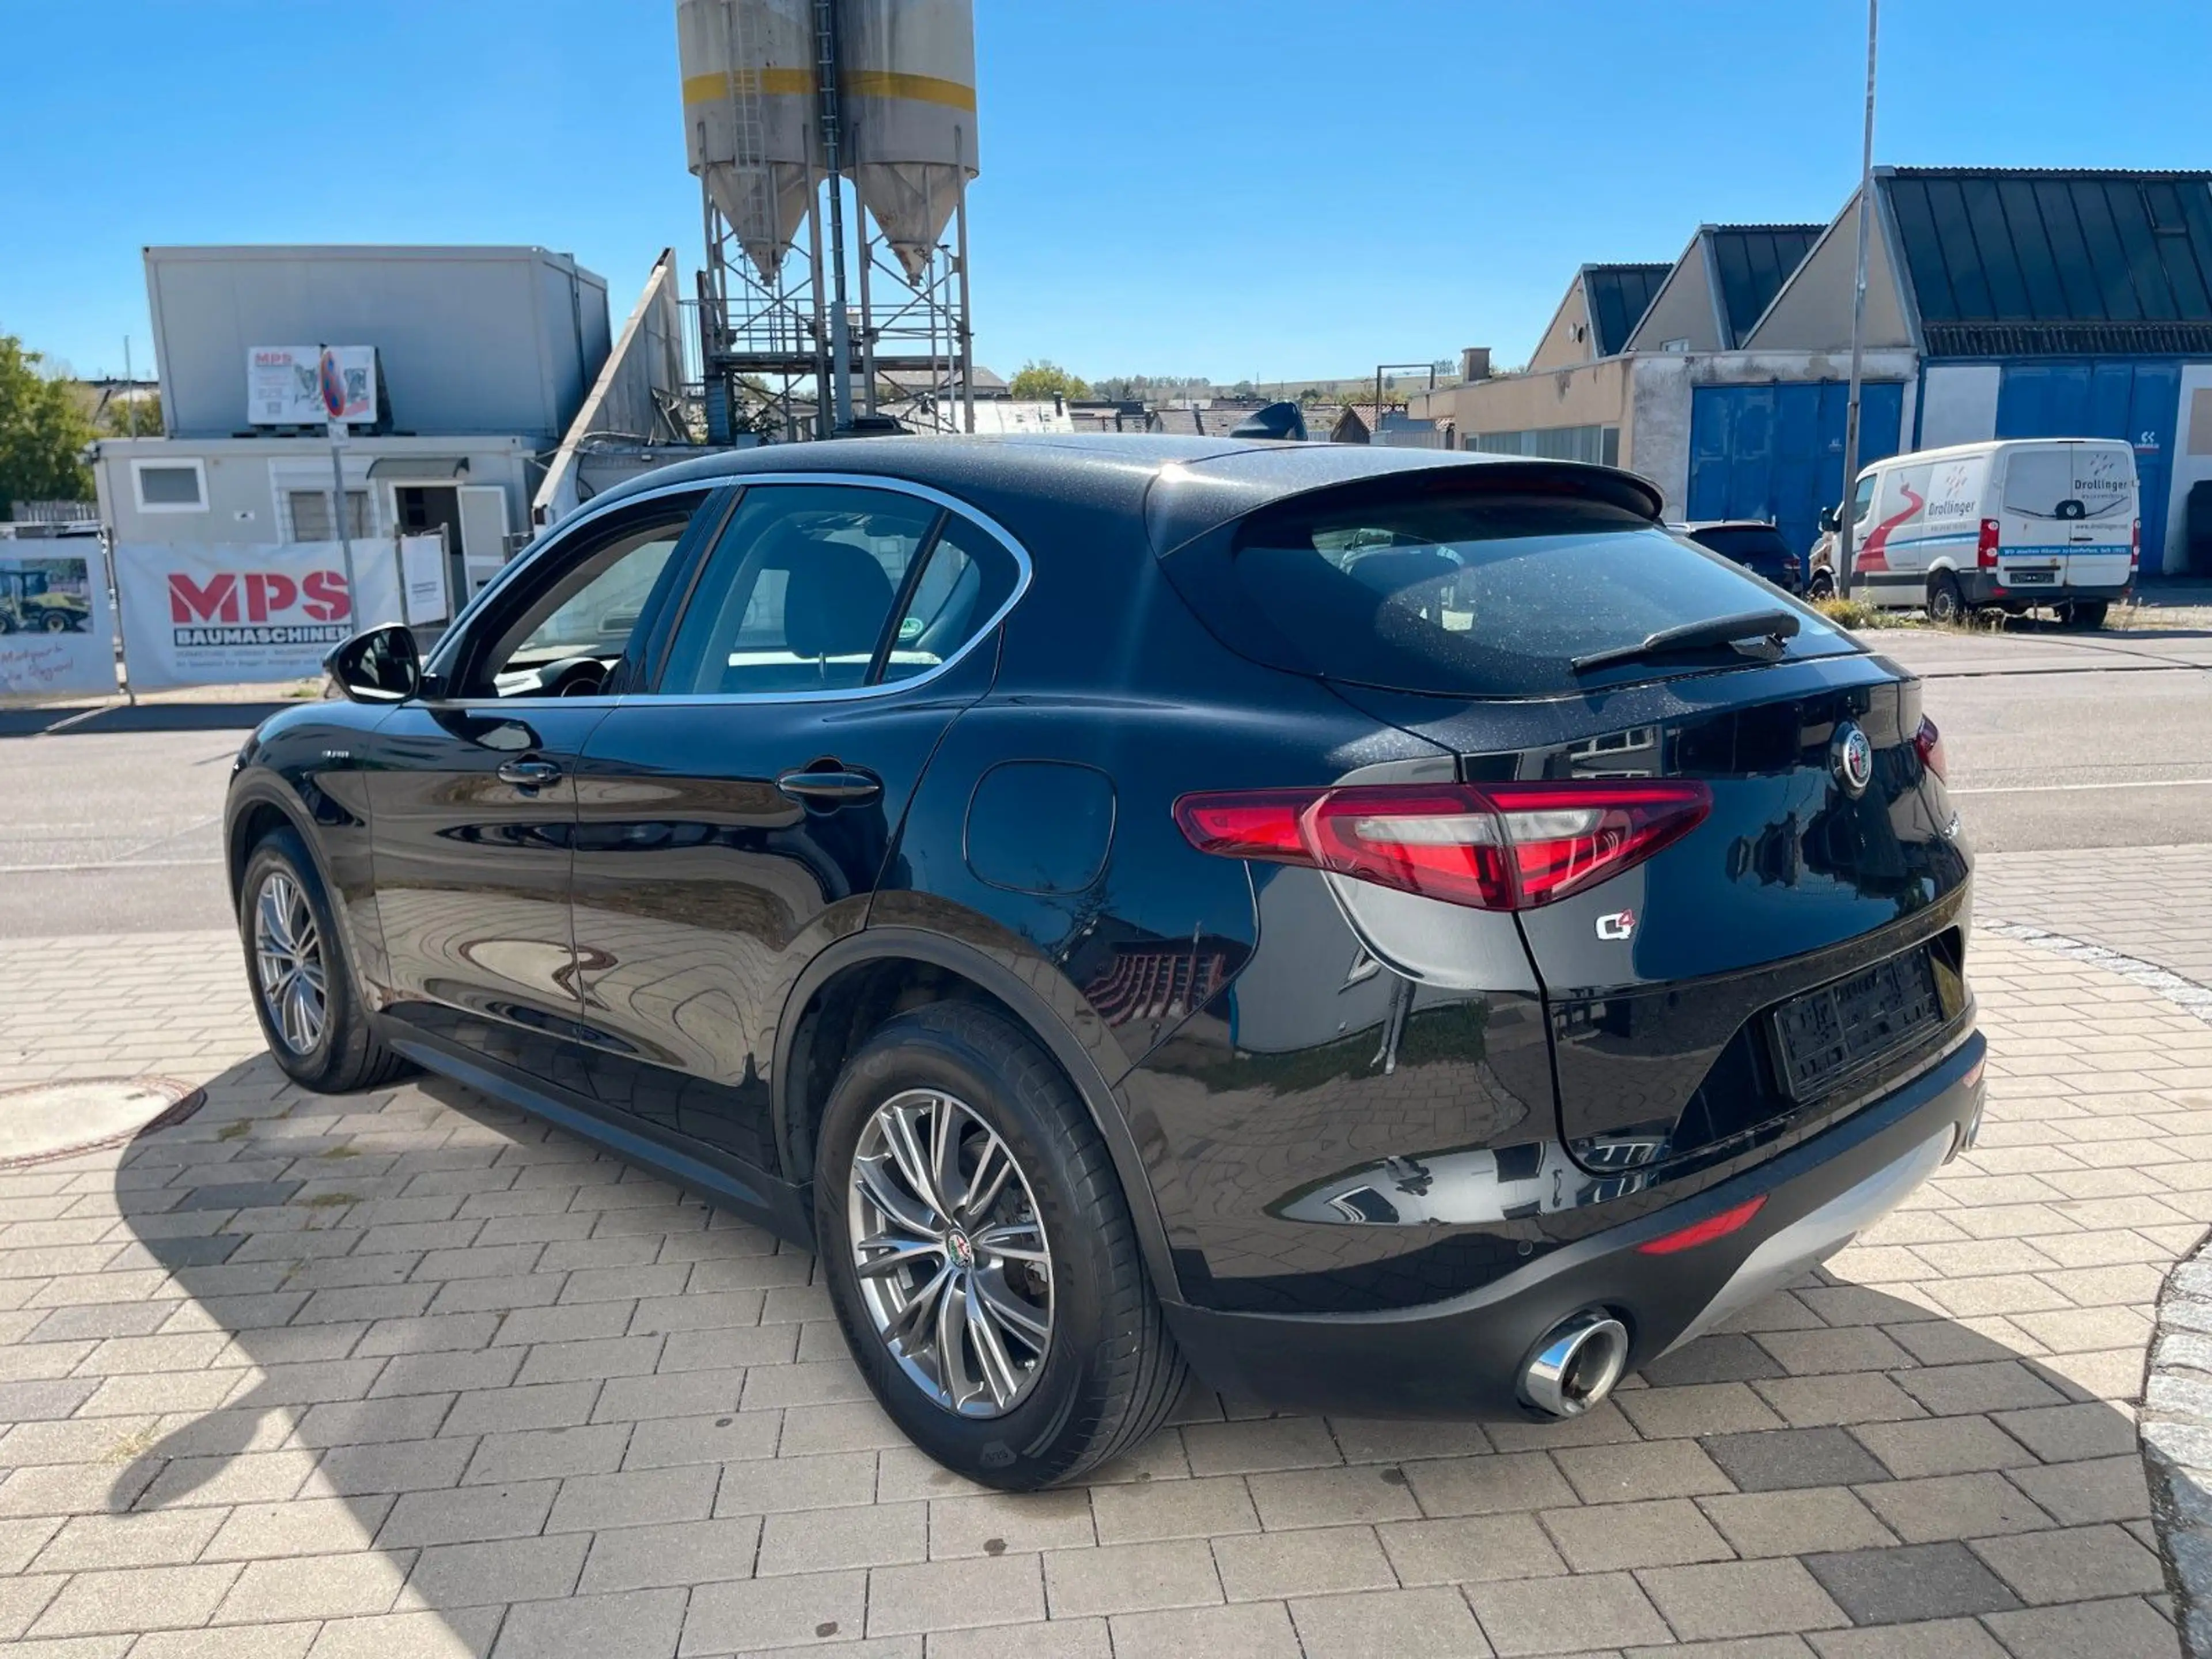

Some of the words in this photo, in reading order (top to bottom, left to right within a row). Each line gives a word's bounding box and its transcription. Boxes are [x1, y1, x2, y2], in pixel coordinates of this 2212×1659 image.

[2075, 480, 2127, 491] Drollinger
[1929, 501, 1975, 516] Drollinger
[168, 570, 352, 623] MPS
[1596, 909, 1636, 940] Q4
